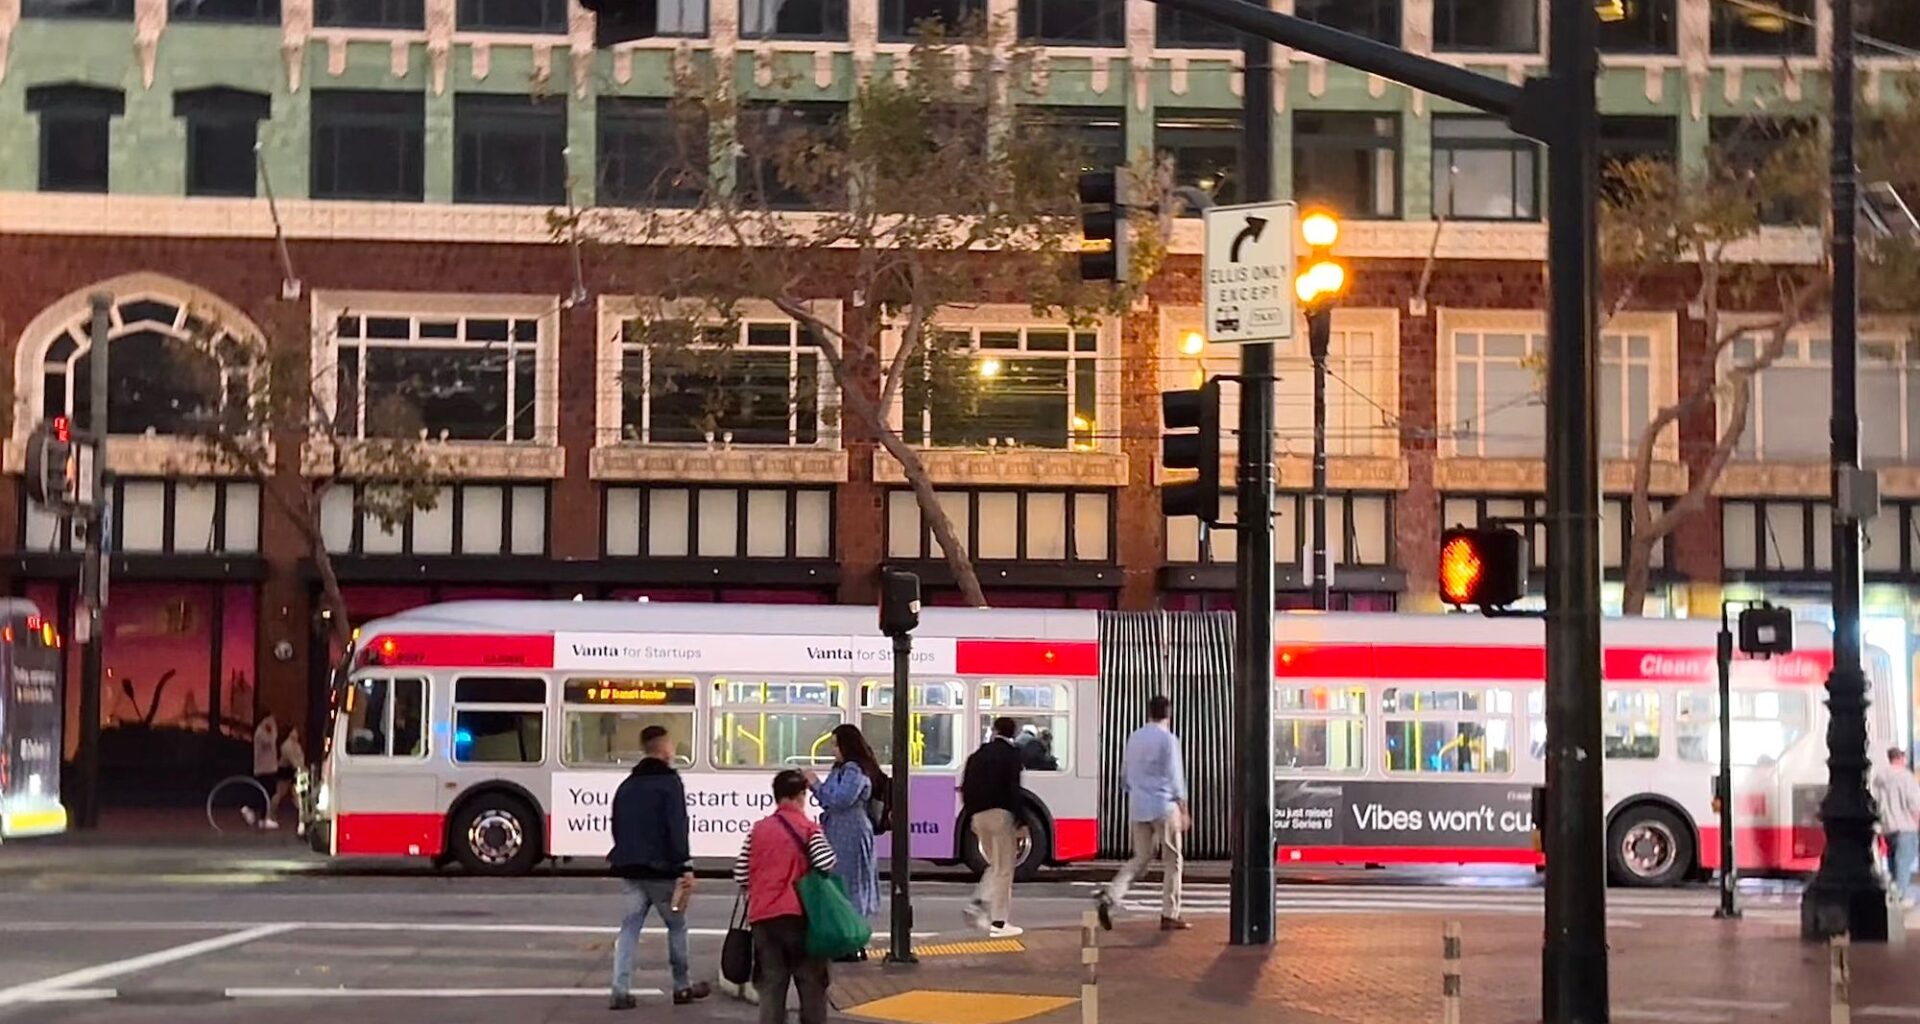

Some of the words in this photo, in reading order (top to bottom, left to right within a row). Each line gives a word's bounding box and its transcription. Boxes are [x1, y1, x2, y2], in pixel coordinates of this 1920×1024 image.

[1210, 266, 1248, 284] ELLIS
[1252, 264, 1286, 281] ONLY
[1220, 285, 1278, 302] EXCEPT
[572, 643, 619, 657] Vanta
[622, 645, 642, 658] for
[644, 645, 702, 660] Startups
[806, 646, 853, 660] Vanta
[856, 648, 876, 661] for
[878, 648, 936, 663] Stups
[1639, 653, 1699, 677] Clean
[568, 787, 609, 806] You
[685, 790, 740, 808] start
[1274, 806, 1286, 818] ou
[1286, 806, 1304, 820] just
[1304, 806, 1334, 818] raised
[1351, 802, 1423, 831] Vibes
[1499, 810, 1537, 833] cu
[909, 820, 940, 835] nta
[1273, 819, 1291, 829] our
[1291, 817, 1322, 830] Series
